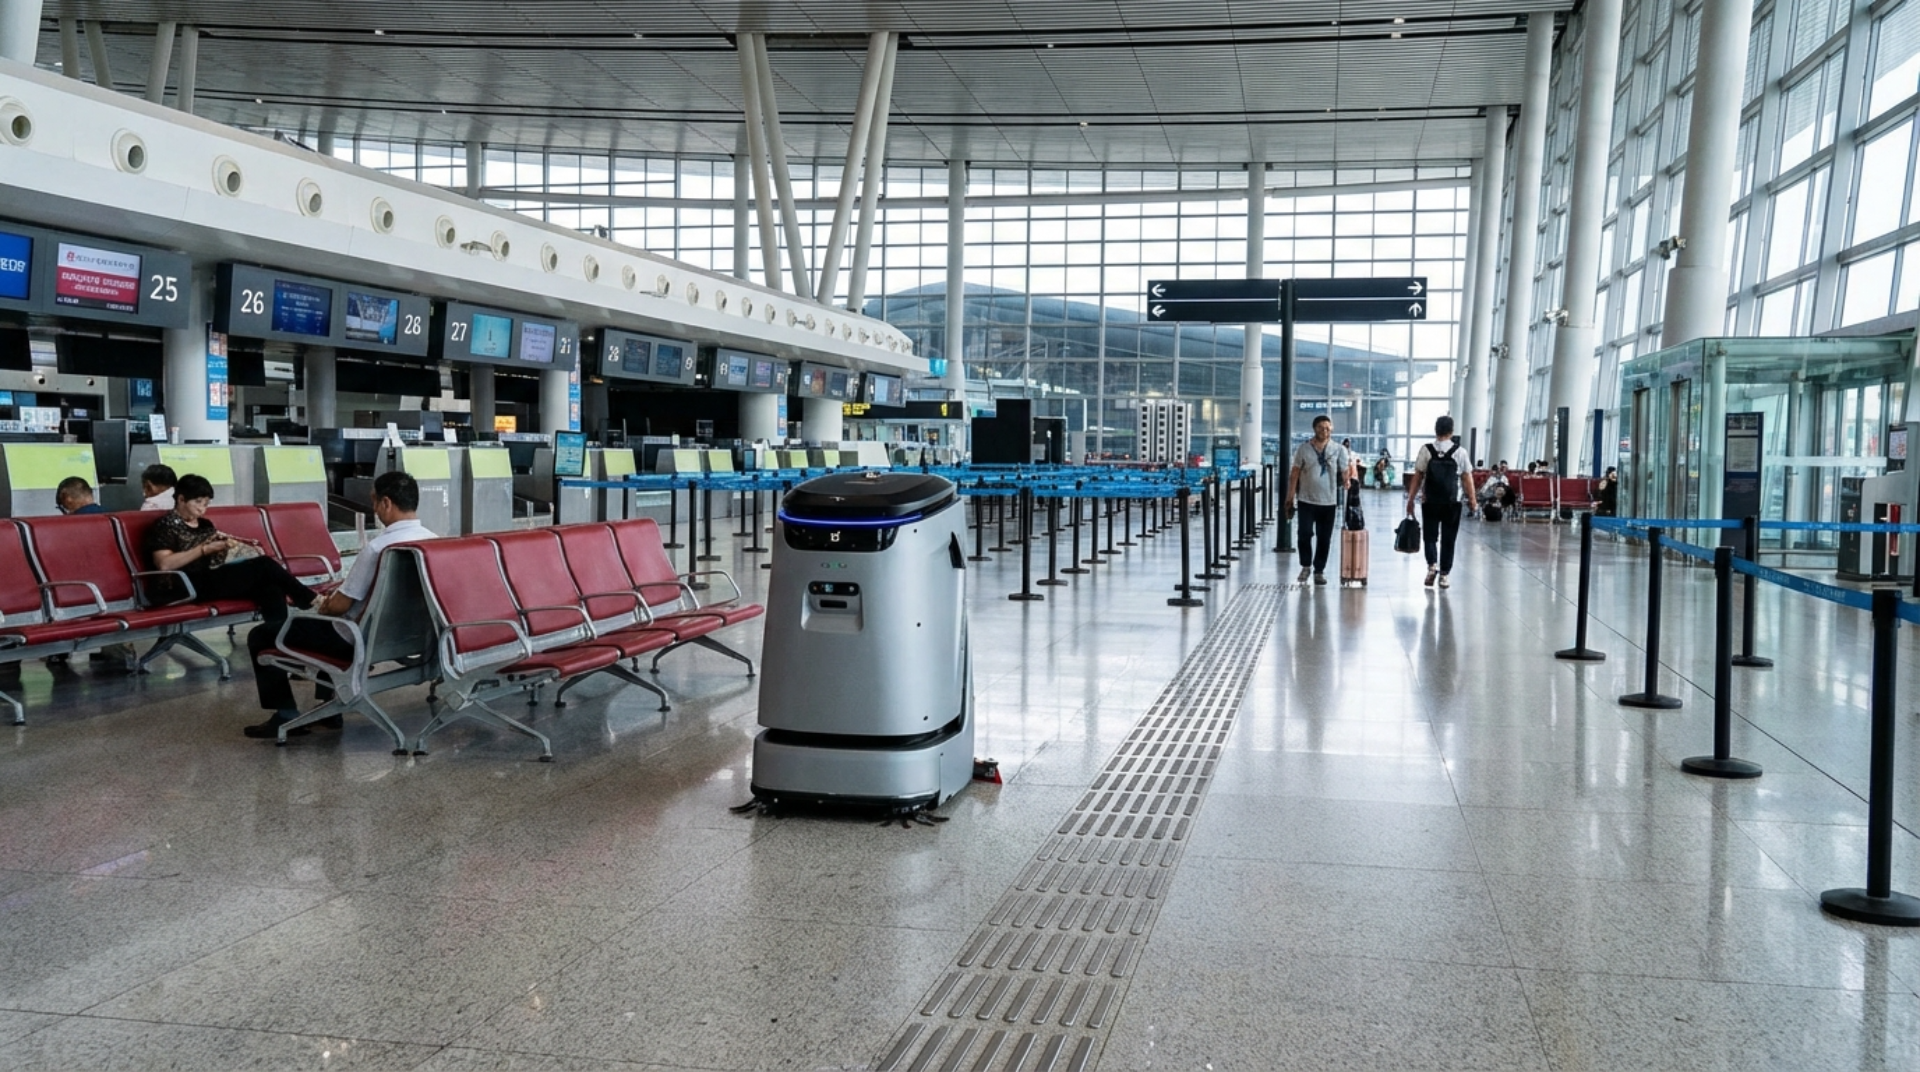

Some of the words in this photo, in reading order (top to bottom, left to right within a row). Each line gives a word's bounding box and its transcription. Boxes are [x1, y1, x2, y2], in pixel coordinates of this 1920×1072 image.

[150, 274, 178, 302] 25
[240, 289, 265, 315] 26
[404, 314, 421, 335] 28
[450, 321, 467, 342] 27
